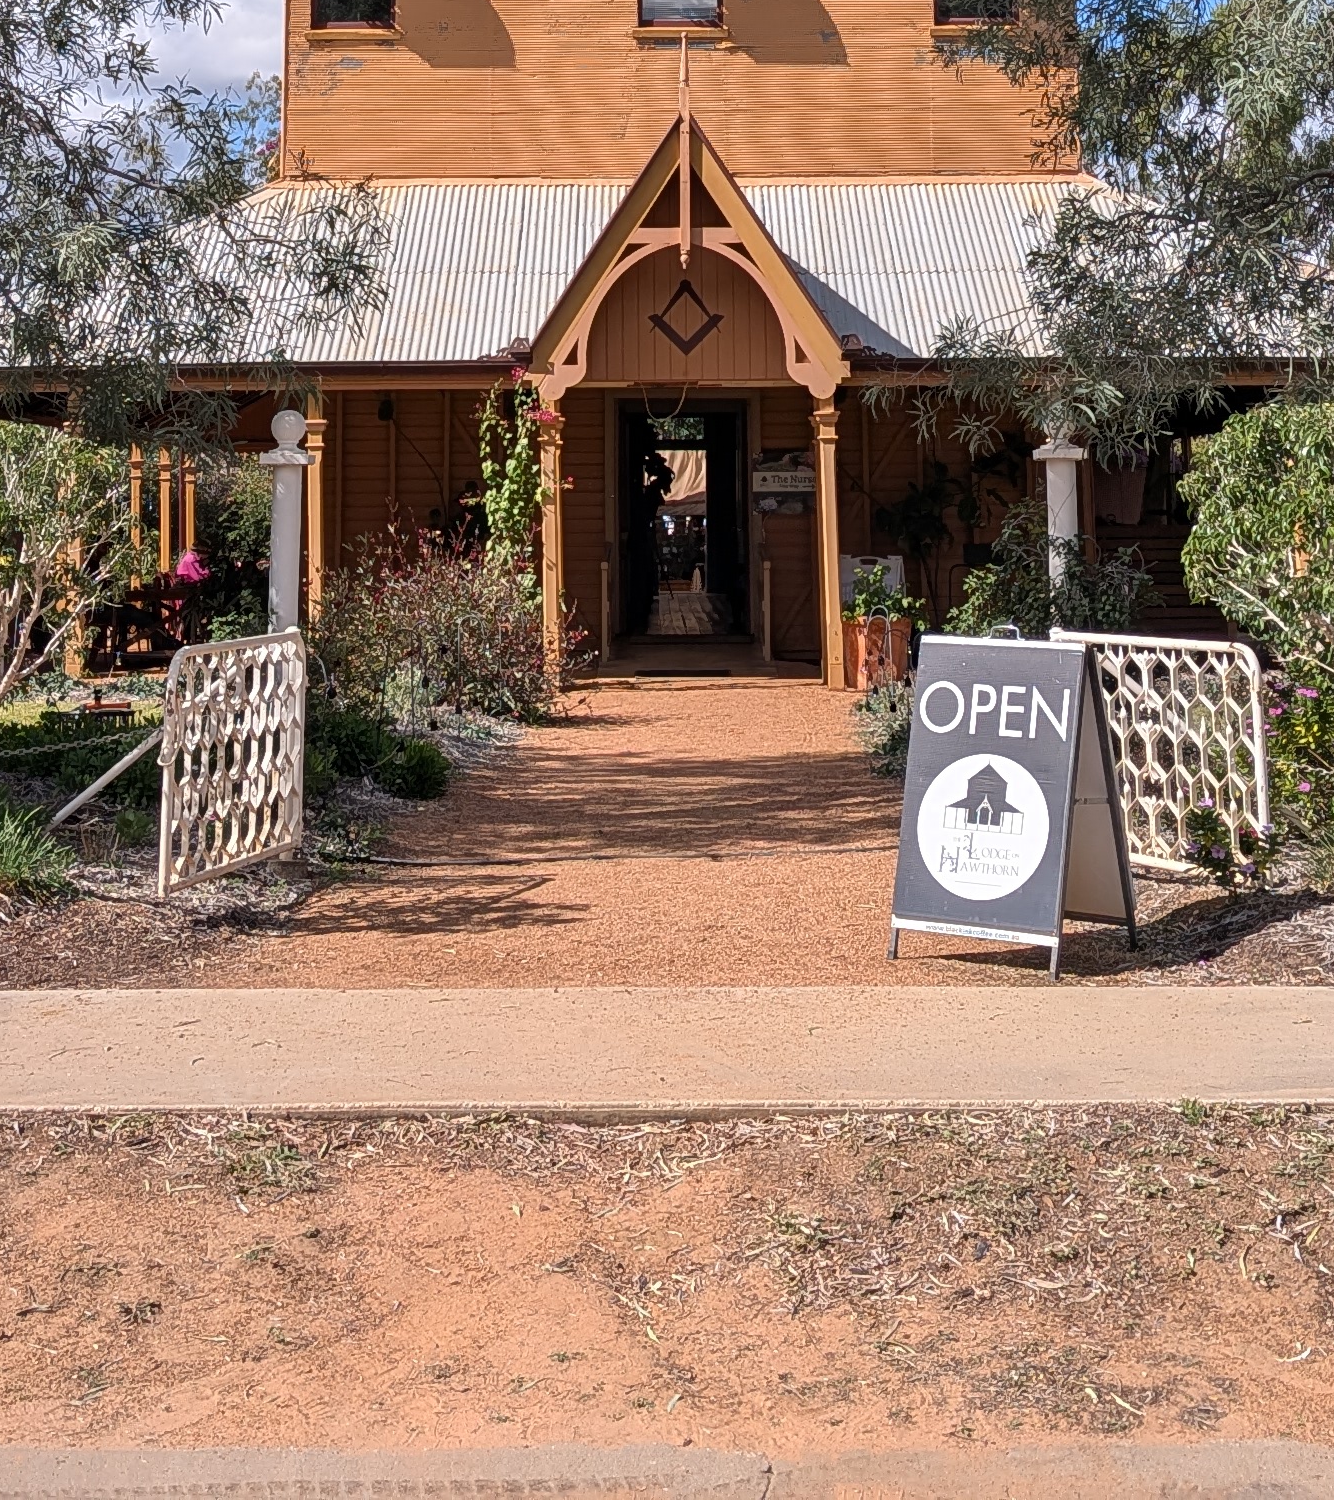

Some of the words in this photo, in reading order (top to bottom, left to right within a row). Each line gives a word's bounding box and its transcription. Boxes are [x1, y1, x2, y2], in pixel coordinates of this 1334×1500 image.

[771, 475, 788, 483] The
[919, 680, 1071, 742] OPEN
[937, 845, 1019, 876] HAWTHORN
[963, 832, 1011, 860] LODGE
